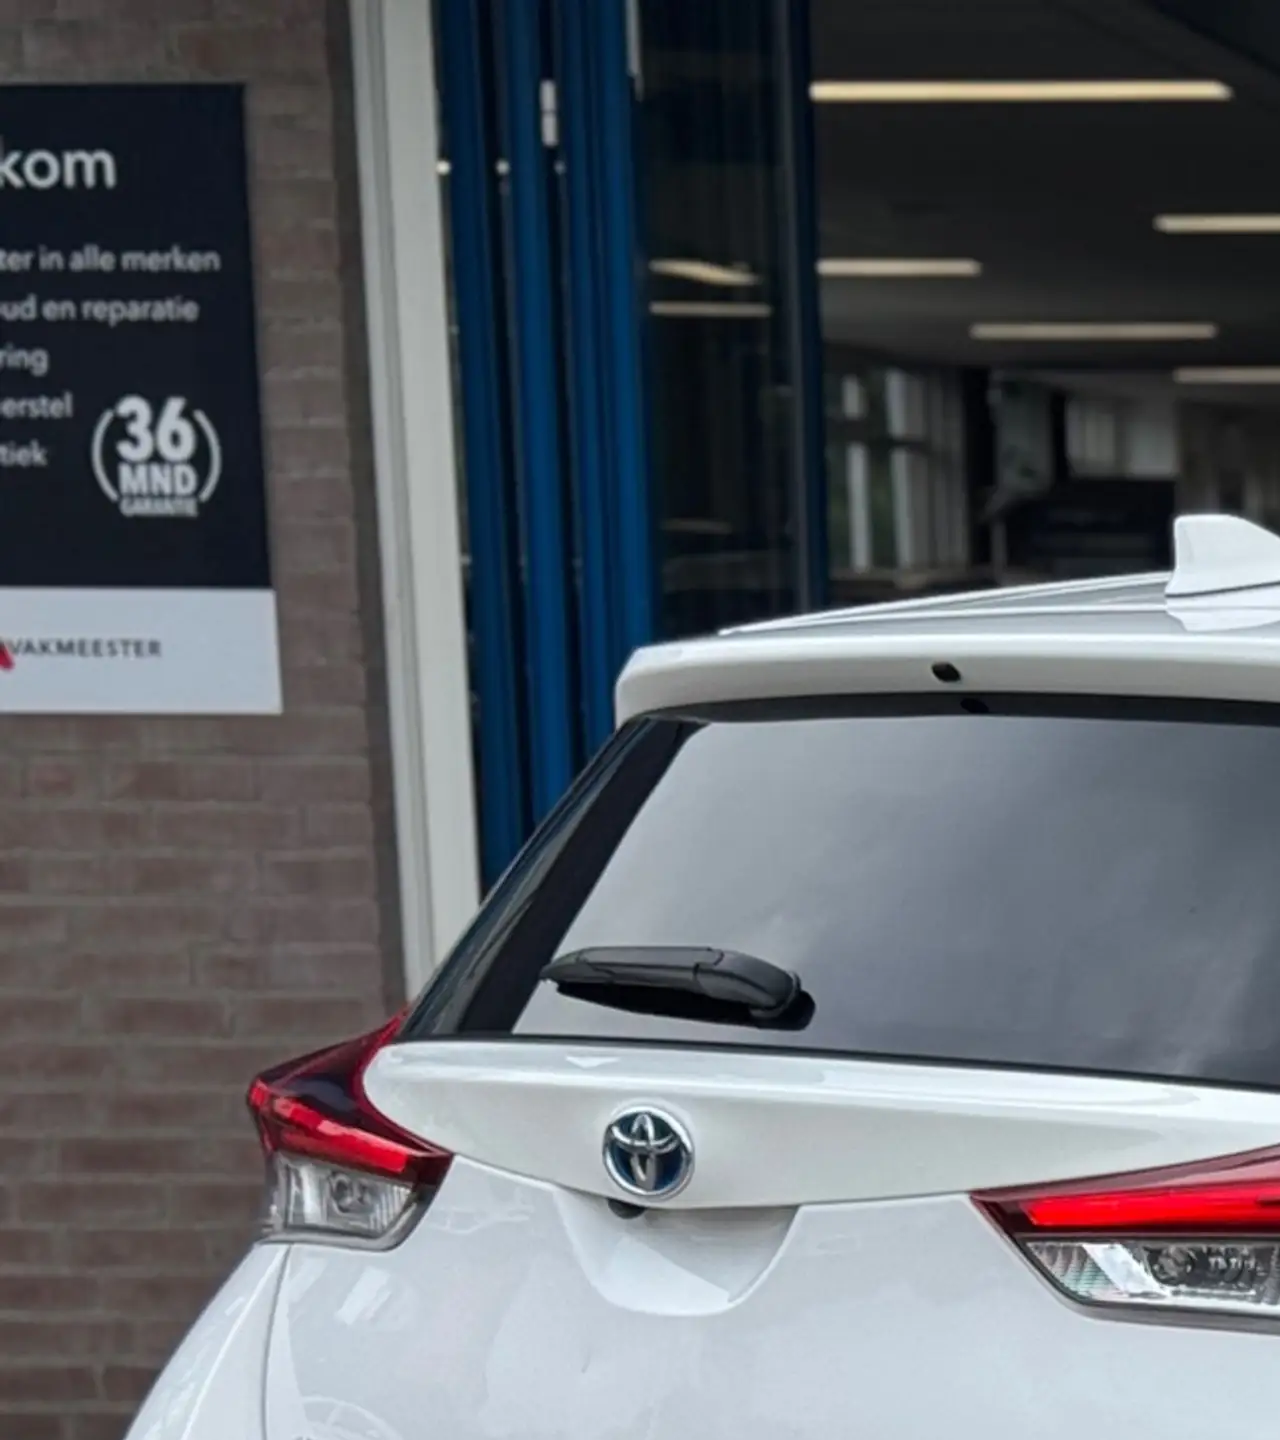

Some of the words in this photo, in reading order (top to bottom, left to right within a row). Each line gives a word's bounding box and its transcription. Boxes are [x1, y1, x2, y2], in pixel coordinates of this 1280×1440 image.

[39, 244, 64, 271] in
[70, 243, 116, 272] alle
[121, 244, 221, 272] merken
[42, 300, 77, 321] en
[82, 295, 200, 328] reparatie
[116, 394, 197, 462] 36
[119, 462, 198, 496] MND
[8, 638, 162, 657] VAKMEESTER
